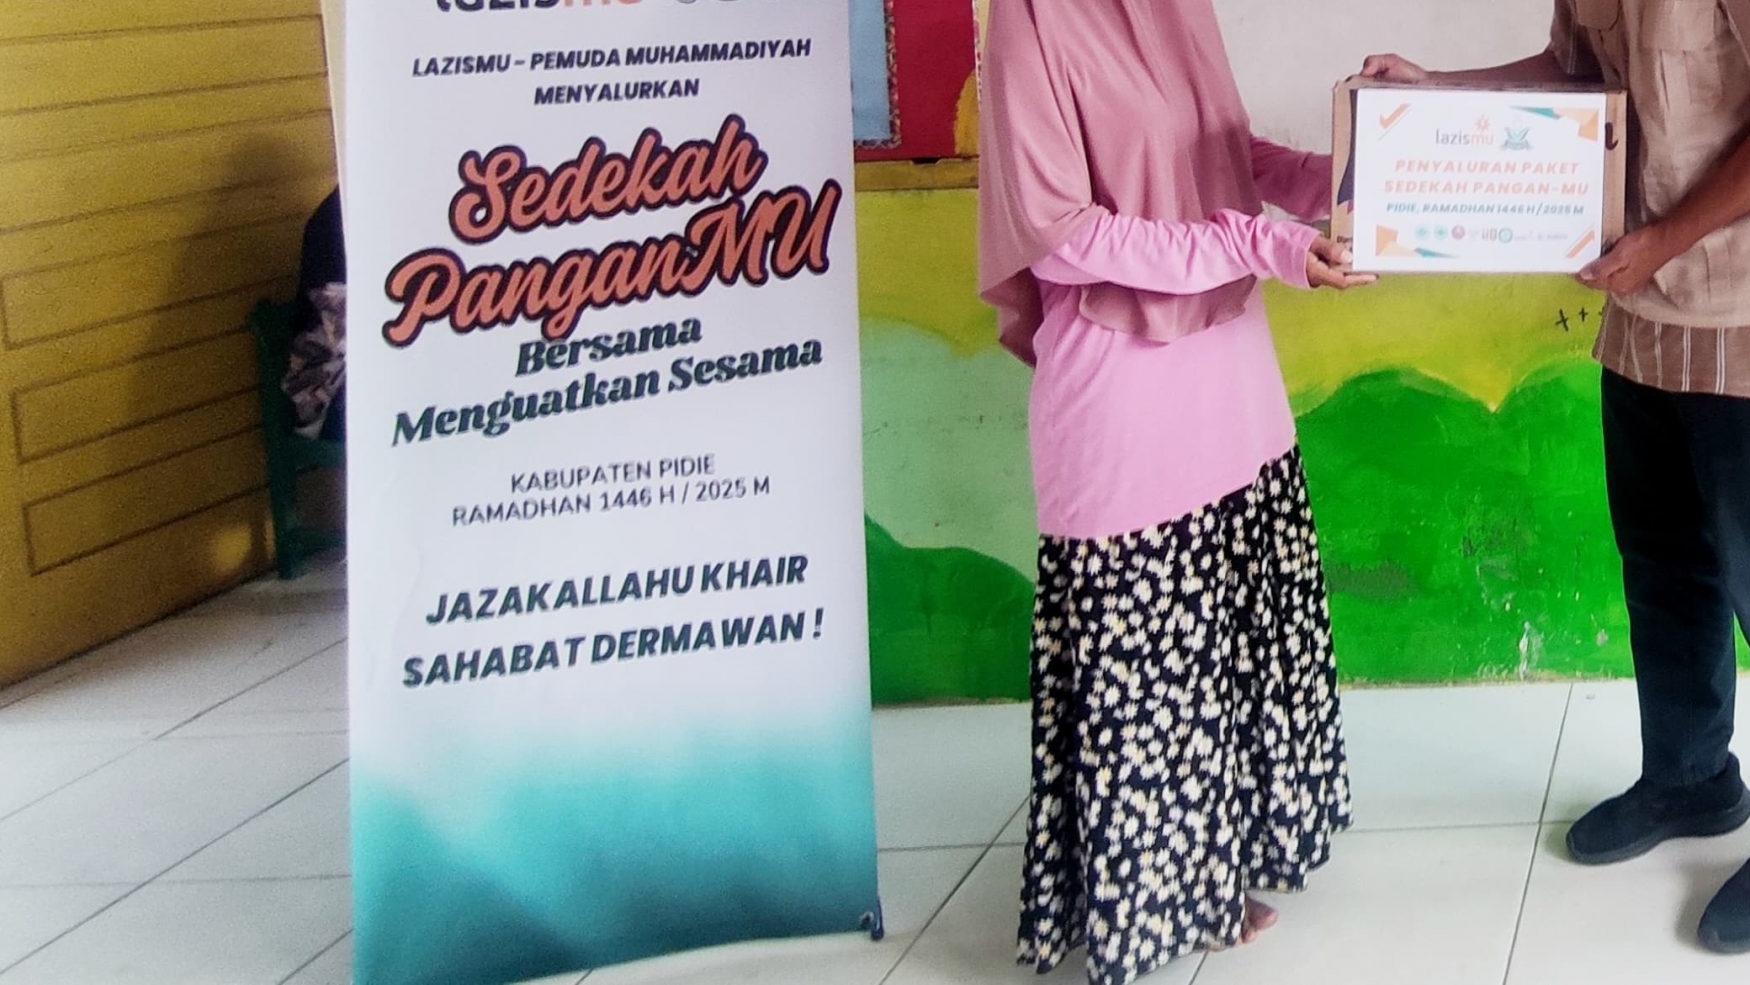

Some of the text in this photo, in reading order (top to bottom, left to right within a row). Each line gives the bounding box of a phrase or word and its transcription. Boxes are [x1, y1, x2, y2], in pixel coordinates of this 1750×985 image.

[411, 38, 812, 77] LAZISMU PEMUDA MUHAMMADIYAH
[534, 79, 700, 105] MENYALURKAN
[1435, 128, 1494, 146] lazismu
[449, 115, 769, 244] Sedekah
[1384, 180, 1470, 194] SEDEKAH
[1395, 160, 1580, 175] PENYALURAN PAKET
[382, 179, 842, 346] PanganMU
[515, 317, 702, 377] Bersama
[391, 339, 823, 447] Menguatkan Sesama
[510, 454, 715, 493] KABUPATEN PIDIE
[452, 477, 770, 526] RAMADHAN 1446 H 2025 M
[426, 555, 808, 625] JAZAKALLAHU KHAIR
[402, 610, 806, 688] SAHABAT DERMAWAN
